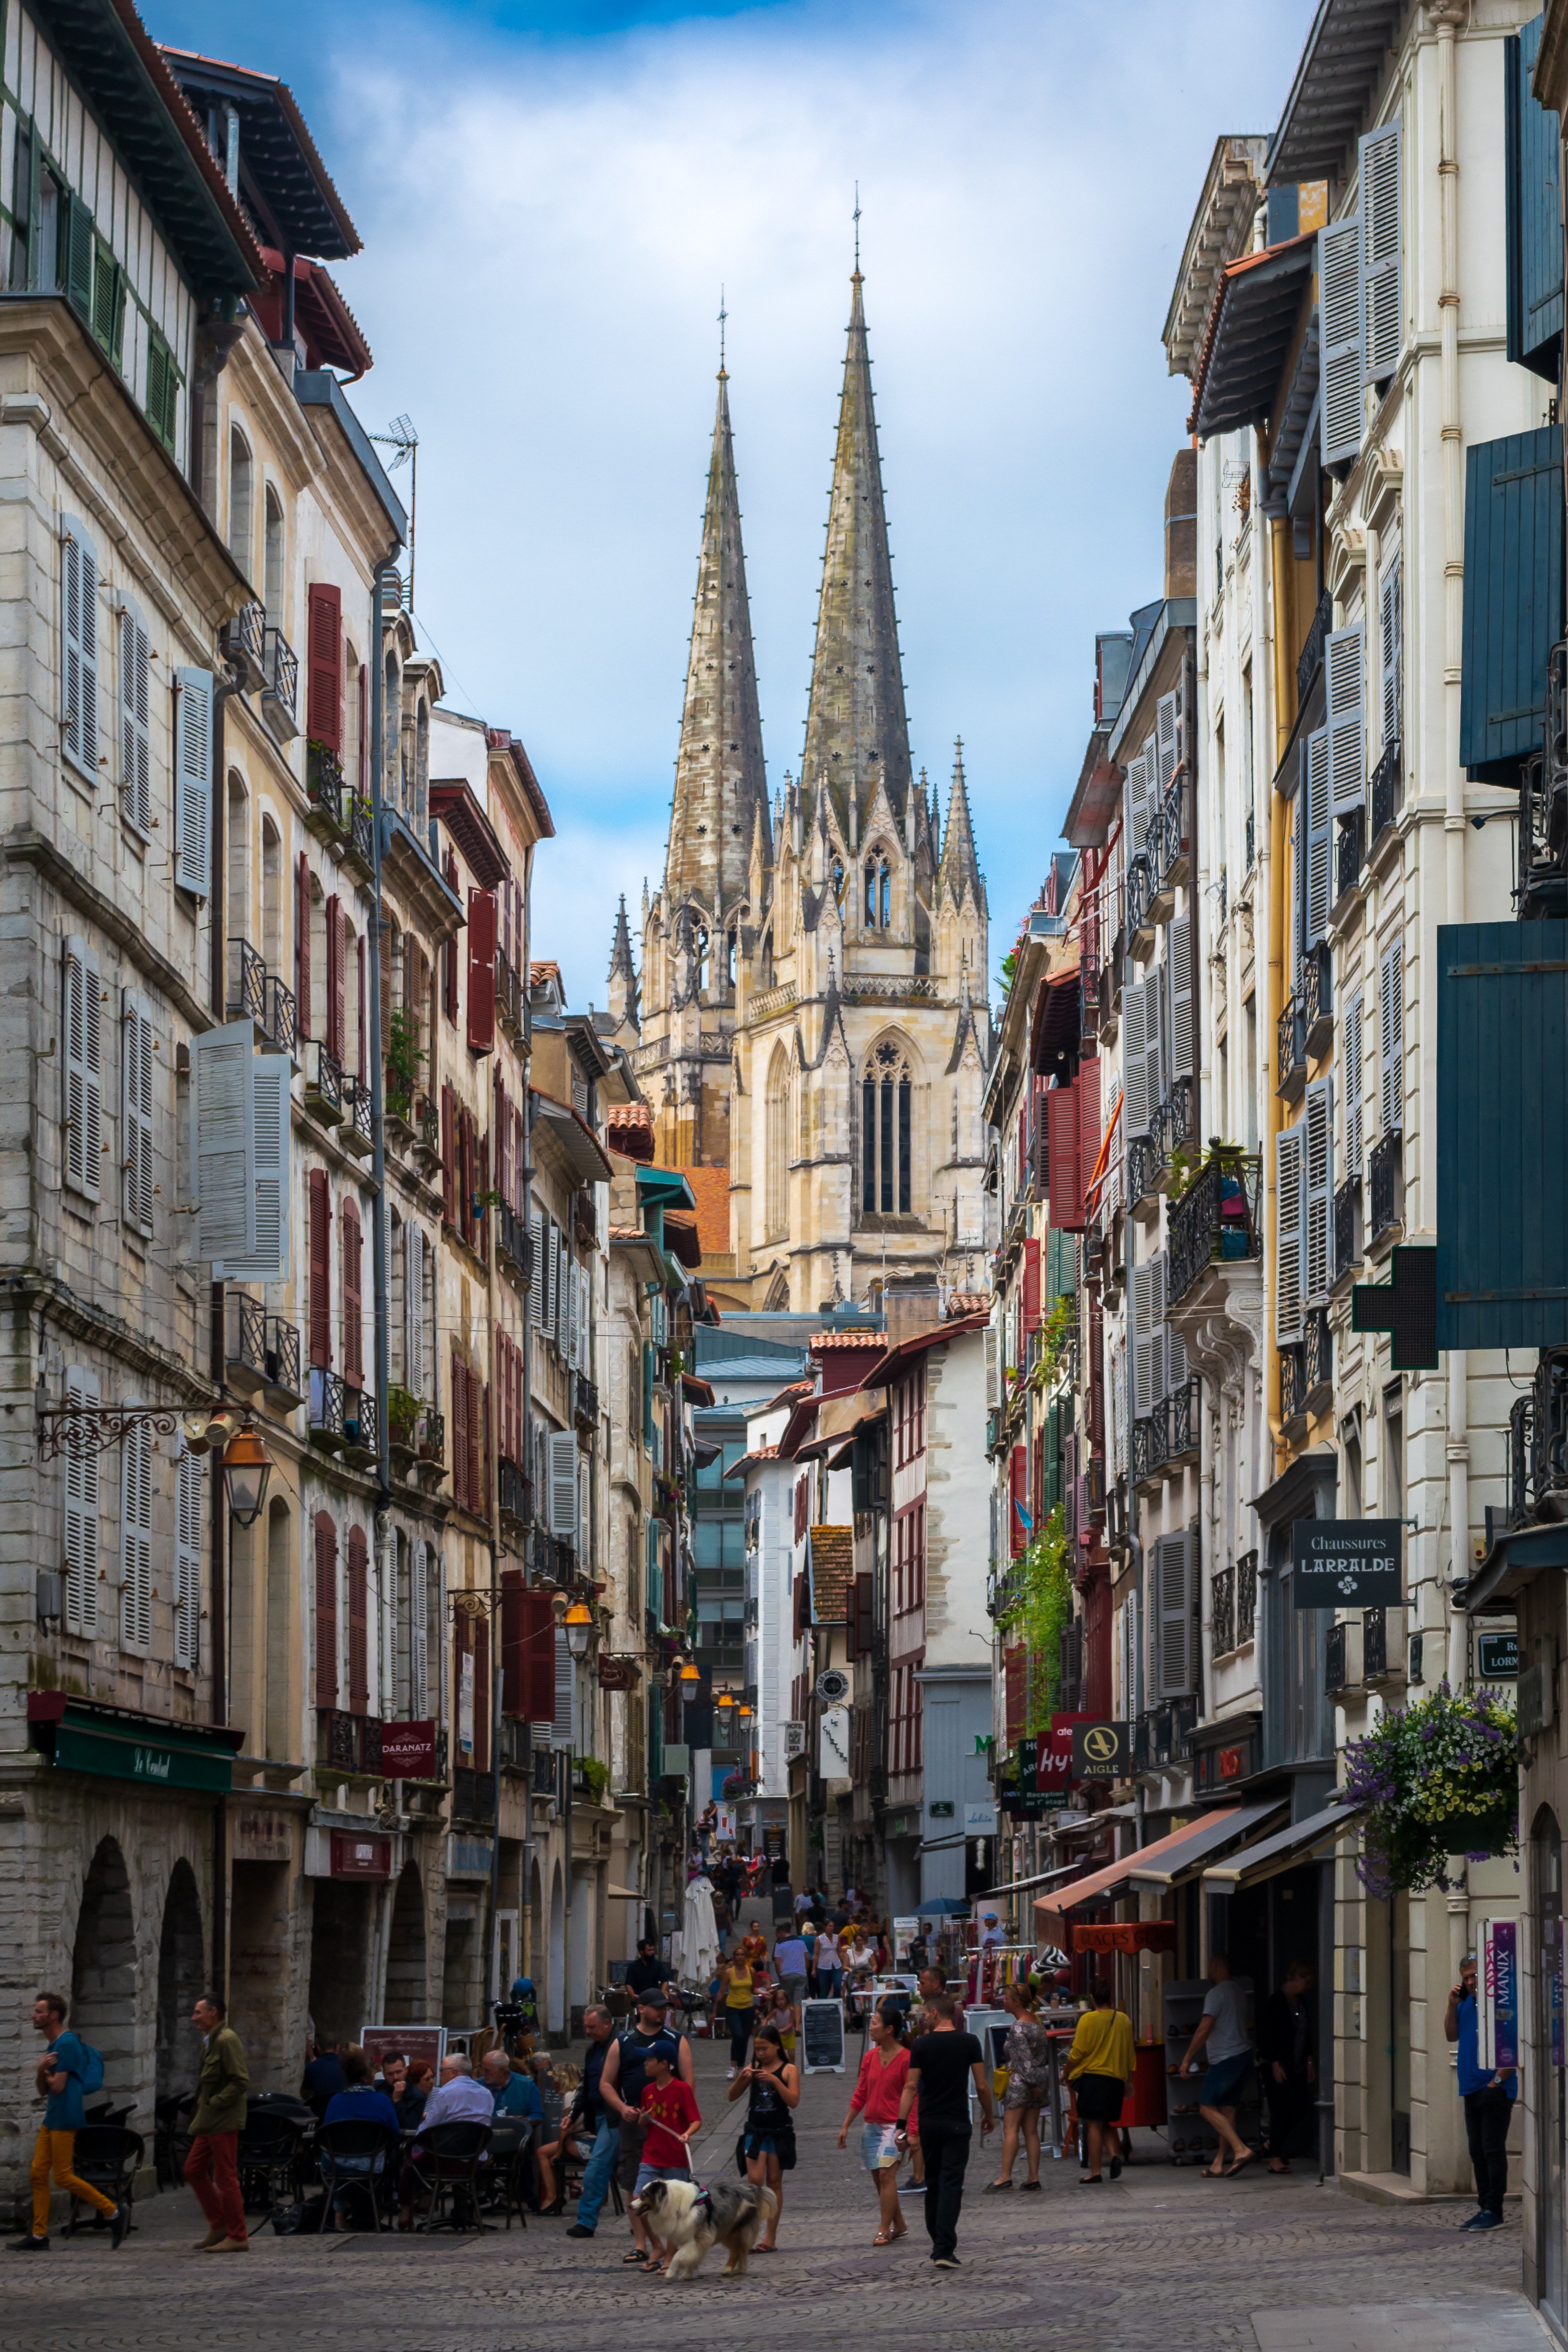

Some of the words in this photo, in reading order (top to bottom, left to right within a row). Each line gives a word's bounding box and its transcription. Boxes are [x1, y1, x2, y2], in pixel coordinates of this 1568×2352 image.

[1311, 1536, 1386, 1550] Chaussures
[1301, 1558, 1395, 1573] LARRALDE
[382, 1743, 432, 1753] DARANATZ
[1083, 1765, 1119, 1774] AIGLE
[1497, 1949, 1510, 2005] MANIX
